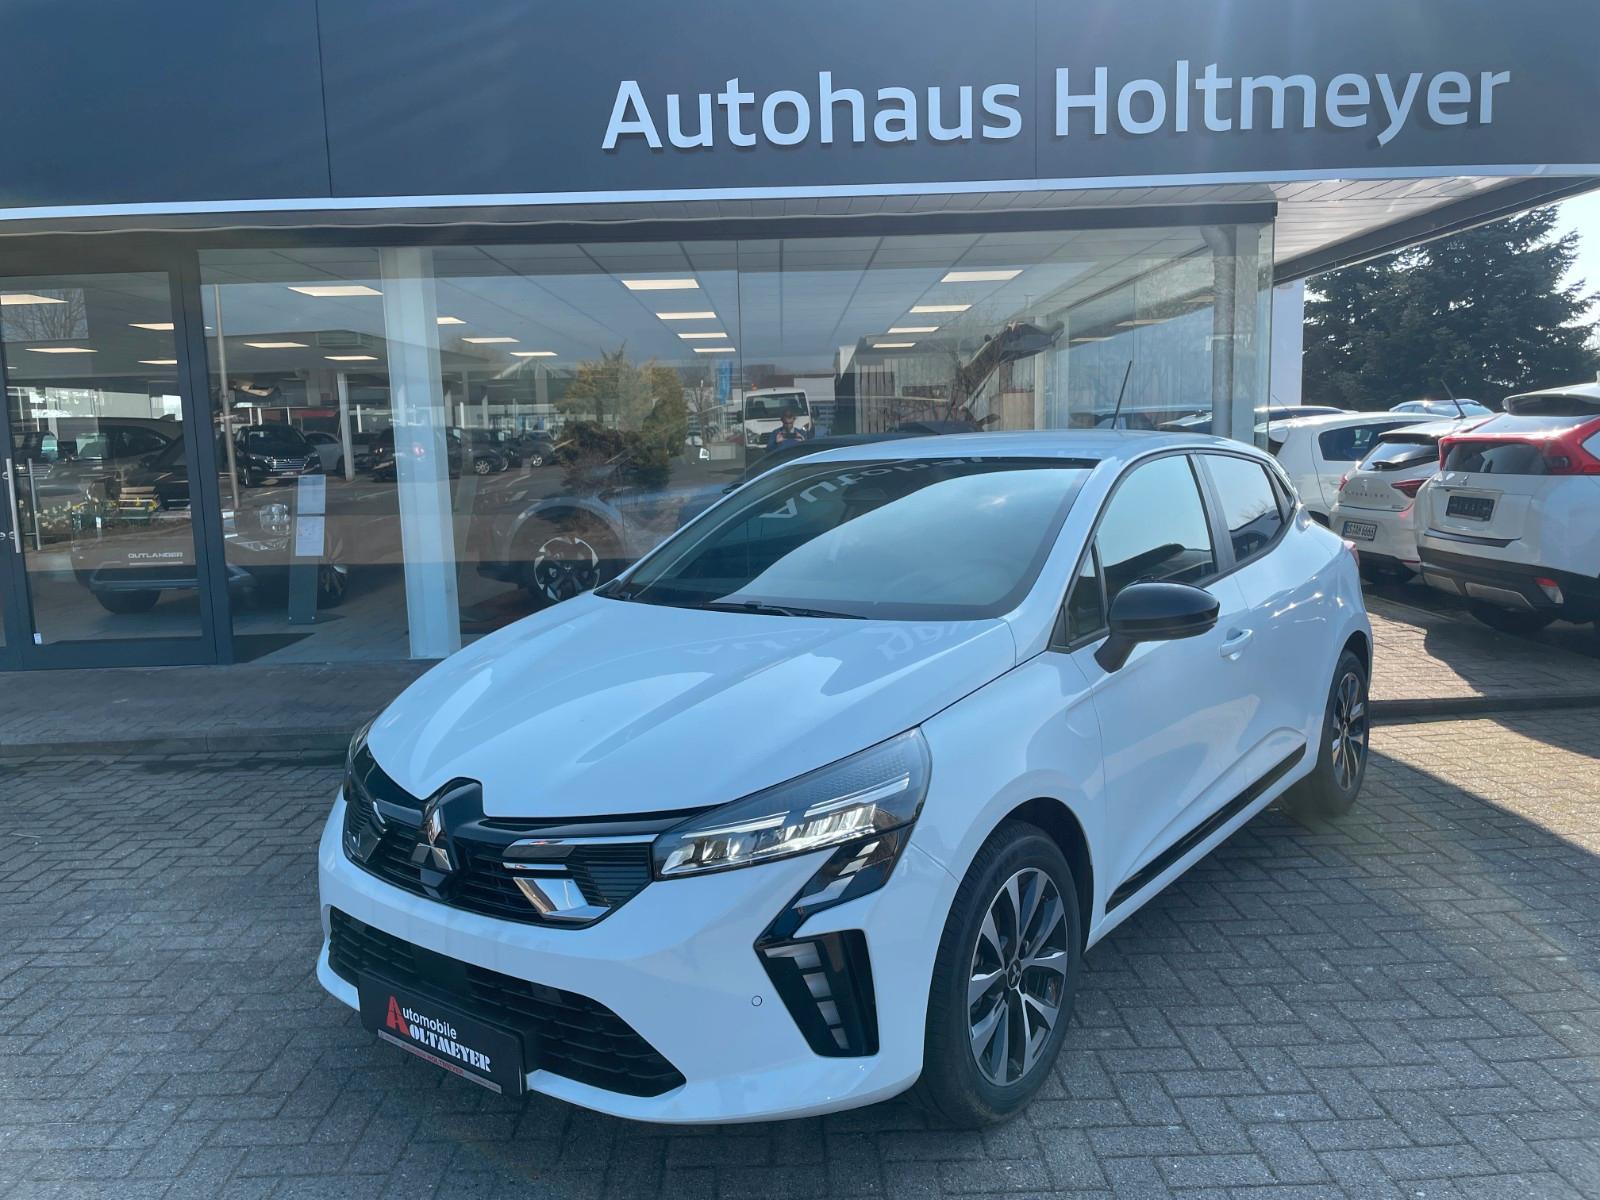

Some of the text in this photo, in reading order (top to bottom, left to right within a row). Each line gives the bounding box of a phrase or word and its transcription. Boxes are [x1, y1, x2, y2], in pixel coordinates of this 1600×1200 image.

[602, 60, 1511, 149] Autohaus Holtmeyer
[385, 995, 457, 1040] Automobile
